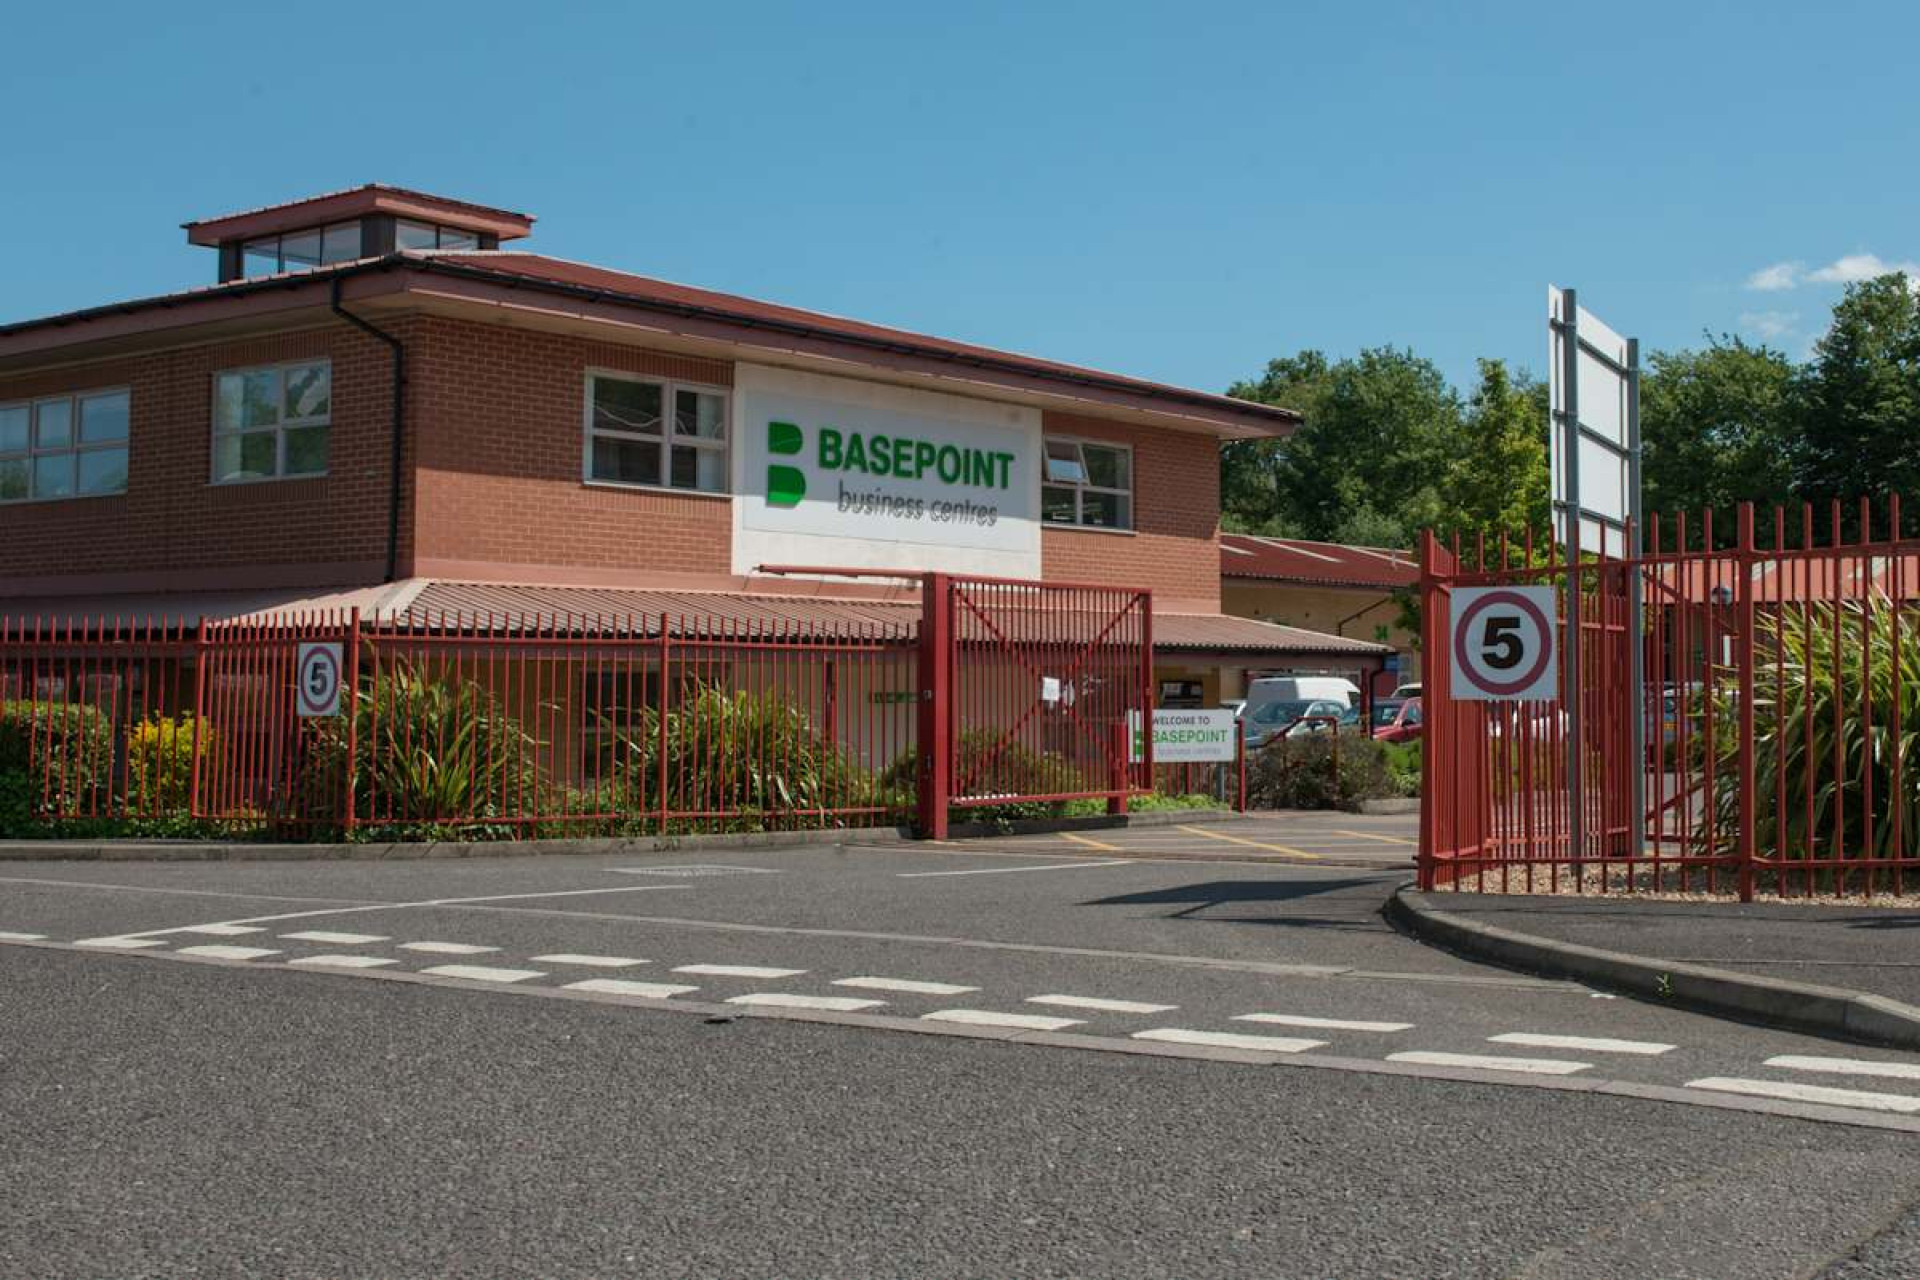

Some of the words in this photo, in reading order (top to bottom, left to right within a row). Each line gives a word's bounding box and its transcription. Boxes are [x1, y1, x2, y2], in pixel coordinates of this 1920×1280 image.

[818, 428, 1015, 490] BASEPOINT
[838, 479, 924, 520] business
[931, 498, 998, 527] centres
[1482, 616, 1524, 670] 5
[310, 662, 327, 696] 5
[1198, 715, 1211, 725] TO
